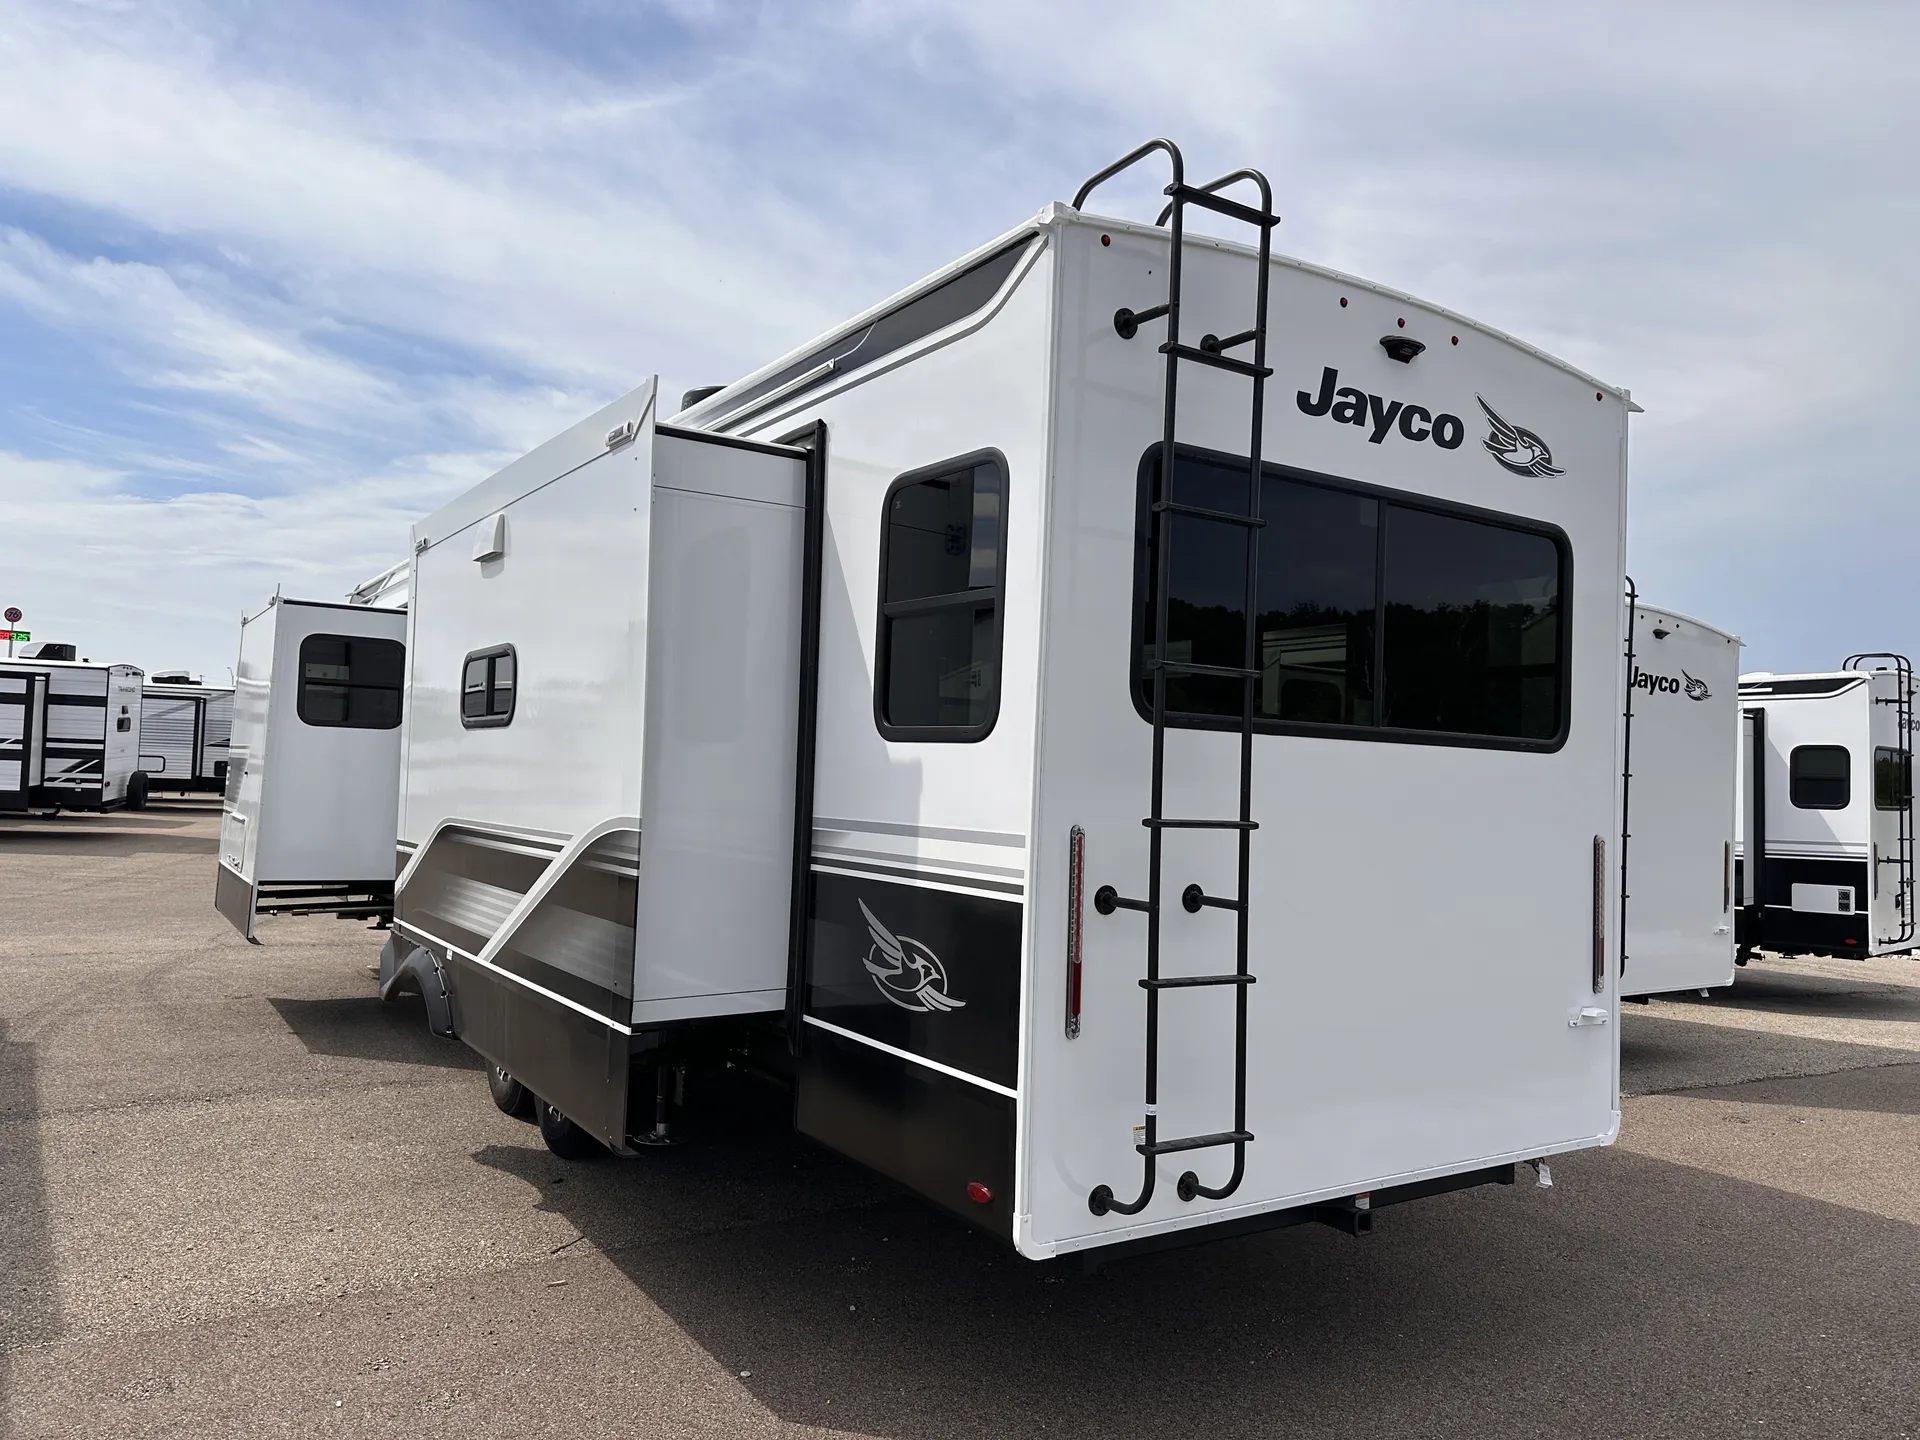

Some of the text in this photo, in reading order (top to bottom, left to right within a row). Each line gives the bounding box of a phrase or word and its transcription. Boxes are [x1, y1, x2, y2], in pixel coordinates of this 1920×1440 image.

[1296, 365, 1465, 450] Jayco
[8, 611, 19, 619] 76
[1630, 666, 1680, 695] Jayco
